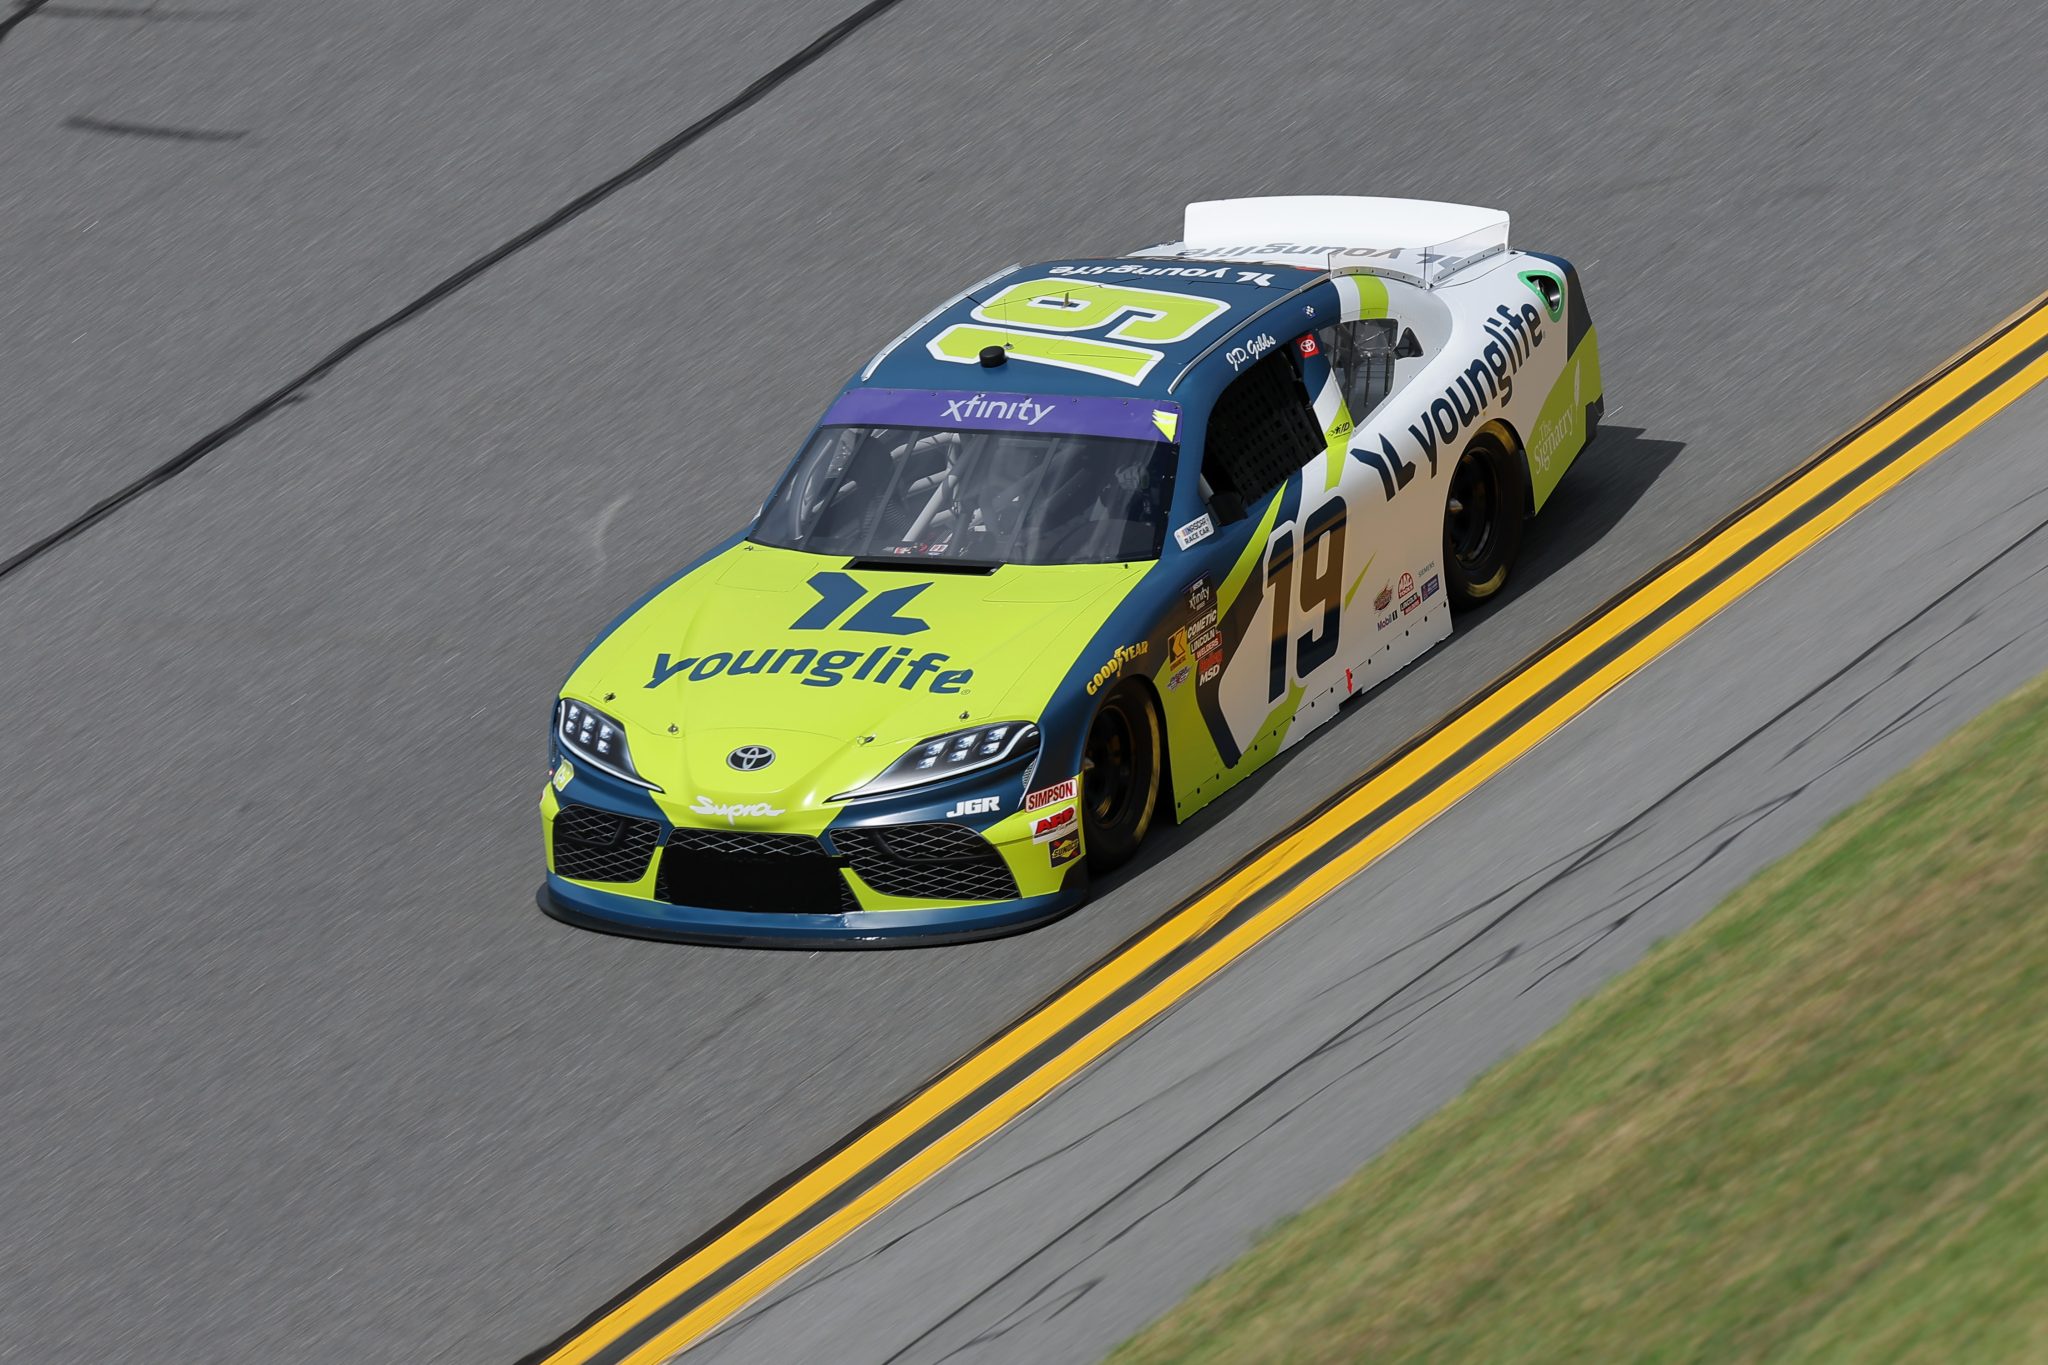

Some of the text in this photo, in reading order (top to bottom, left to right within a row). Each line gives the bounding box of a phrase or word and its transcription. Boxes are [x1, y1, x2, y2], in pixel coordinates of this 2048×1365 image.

[1049, 264, 1231, 279] younglife
[925, 277, 1232, 387] 19
[1246, 333, 1276, 360] Gibbs
[1408, 303, 1543, 479] younglife
[940, 394, 1056, 426] xfinity
[1540, 421, 1552, 440] The
[1184, 526, 1210, 545] RACE CAR
[1189, 586, 1210, 610] xfinity
[1267, 496, 1347, 704] 19
[1187, 609, 1218, 639] COMETIC
[1378, 613, 1392, 631] Mobil
[1190, 627, 1215, 652] LINCOLN
[1196, 639, 1219, 660] WELDERS
[643, 646, 974, 694] younglife
[1086, 641, 1149, 695] GOODYEAR
[1199, 663, 1220, 687] MSD
[946, 796, 1000, 818] JGR
[1028, 781, 1073, 810] SIMPSON
[690, 796, 785, 826] Supra
